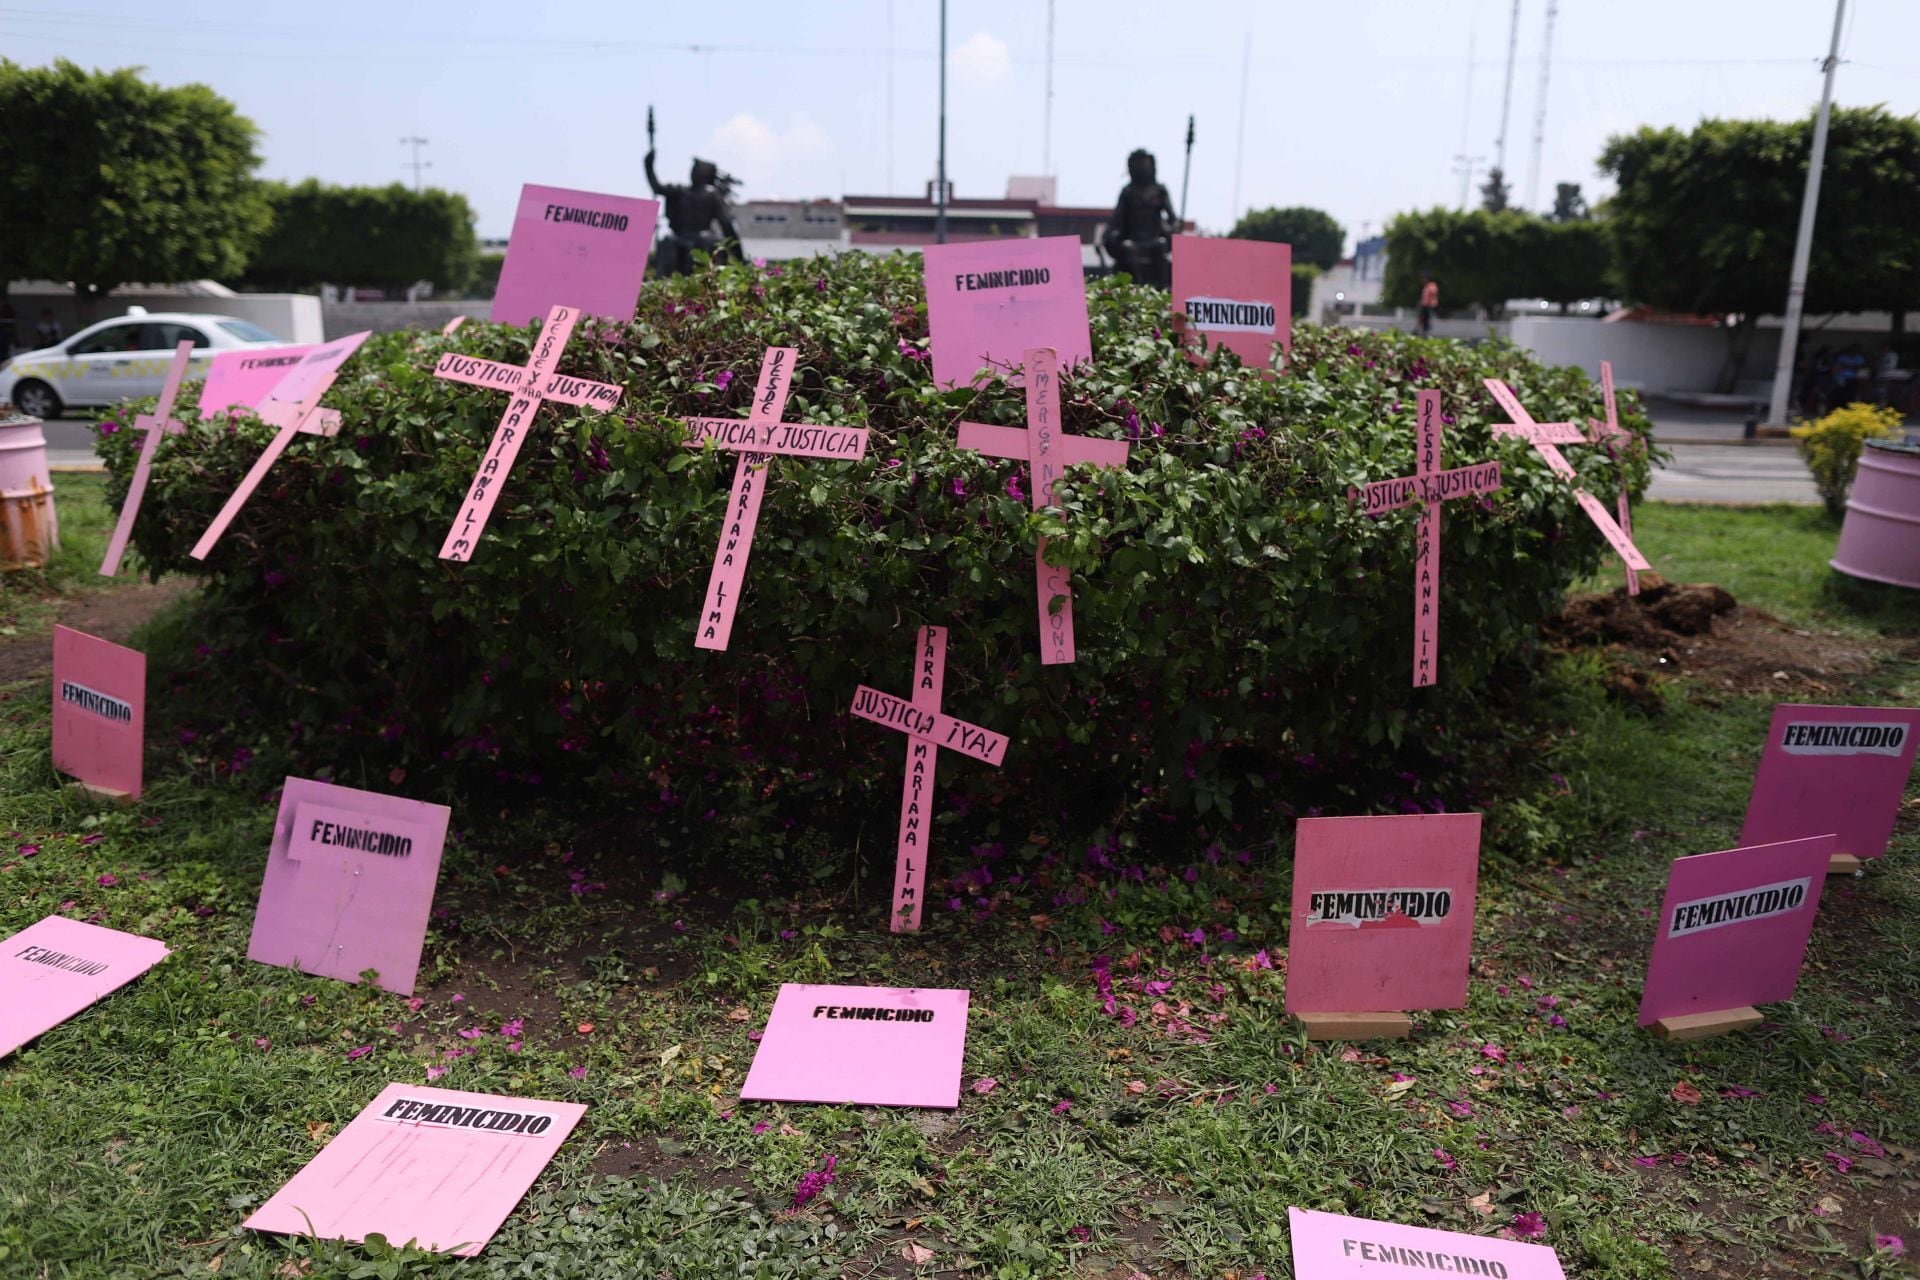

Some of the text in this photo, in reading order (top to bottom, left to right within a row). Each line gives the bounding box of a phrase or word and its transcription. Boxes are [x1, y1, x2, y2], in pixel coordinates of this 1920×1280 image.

[545, 205, 628, 232] FEMINICIDIO
[955, 268, 1050, 291] FEMINICIDIO
[1185, 302, 1275, 327] FEMINICIDIO
[534, 309, 568, 369] DESDE
[439, 355, 522, 383] JUSTICIA
[547, 376, 618, 405] JUSTICIA
[761, 351, 784, 415] DESDE
[472, 399, 530, 501] MARIANA
[766, 426, 777, 445] Y
[777, 426, 859, 453] JUSTICIA
[1435, 467, 1497, 495] JUSTICIA
[704, 465, 755, 639] MARIANA LIMA
[1419, 509, 1433, 685] MARIANA LIMA
[921, 628, 937, 689] PARA
[62, 682, 132, 725] FEMINICIDIO
[855, 690, 935, 735] JUSTICIA
[1783, 725, 1904, 748] FEMINICIDIO
[310, 820, 413, 858] FEMINICIDIO
[900, 743, 927, 917] MARIANA LIM
[1309, 891, 1451, 920] FEMINICIDIO
[1672, 874, 1804, 931] FEMINICIDIO
[14, 945, 109, 977] FEMINICIDIO
[813, 1006, 935, 1023] FEMINICIDIO
[384, 1099, 552, 1135] FEMINICIDIO
[1342, 1238, 1509, 1280] FEMINICIDIO
